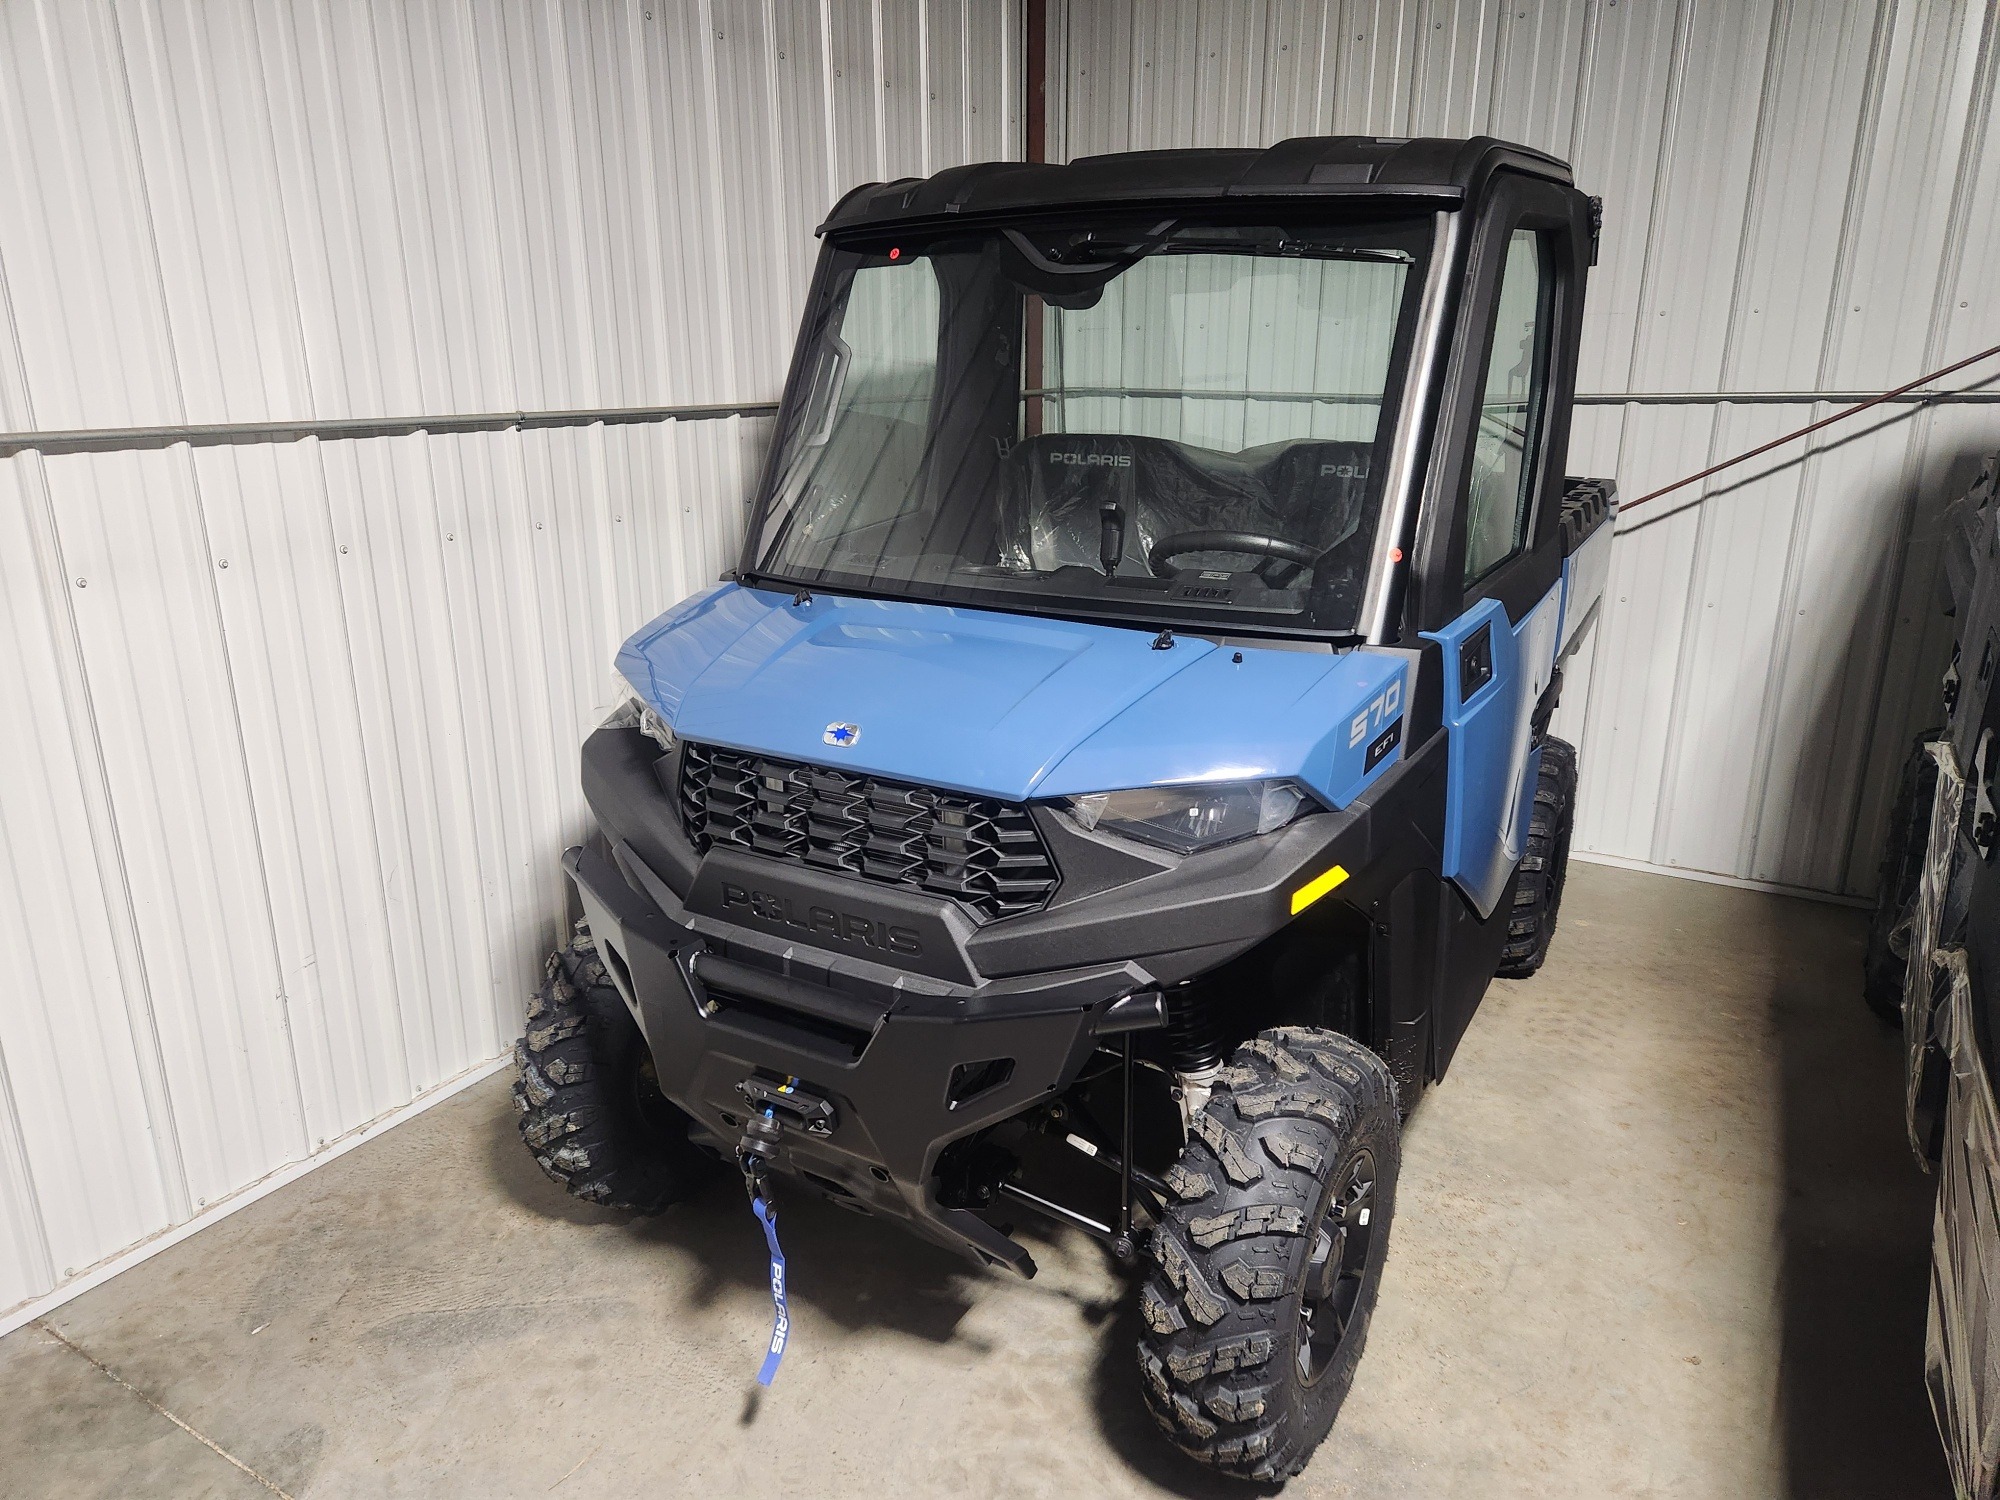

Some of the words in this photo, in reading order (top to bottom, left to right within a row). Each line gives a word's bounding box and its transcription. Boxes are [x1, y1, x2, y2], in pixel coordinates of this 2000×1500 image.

[1050, 452, 1131, 467] POLARIS
[1350, 680, 1400, 749] 570
[1374, 732, 1394, 757] EFI
[721, 882, 923, 957] POLARIS
[771, 1262, 788, 1354] POLARIS
